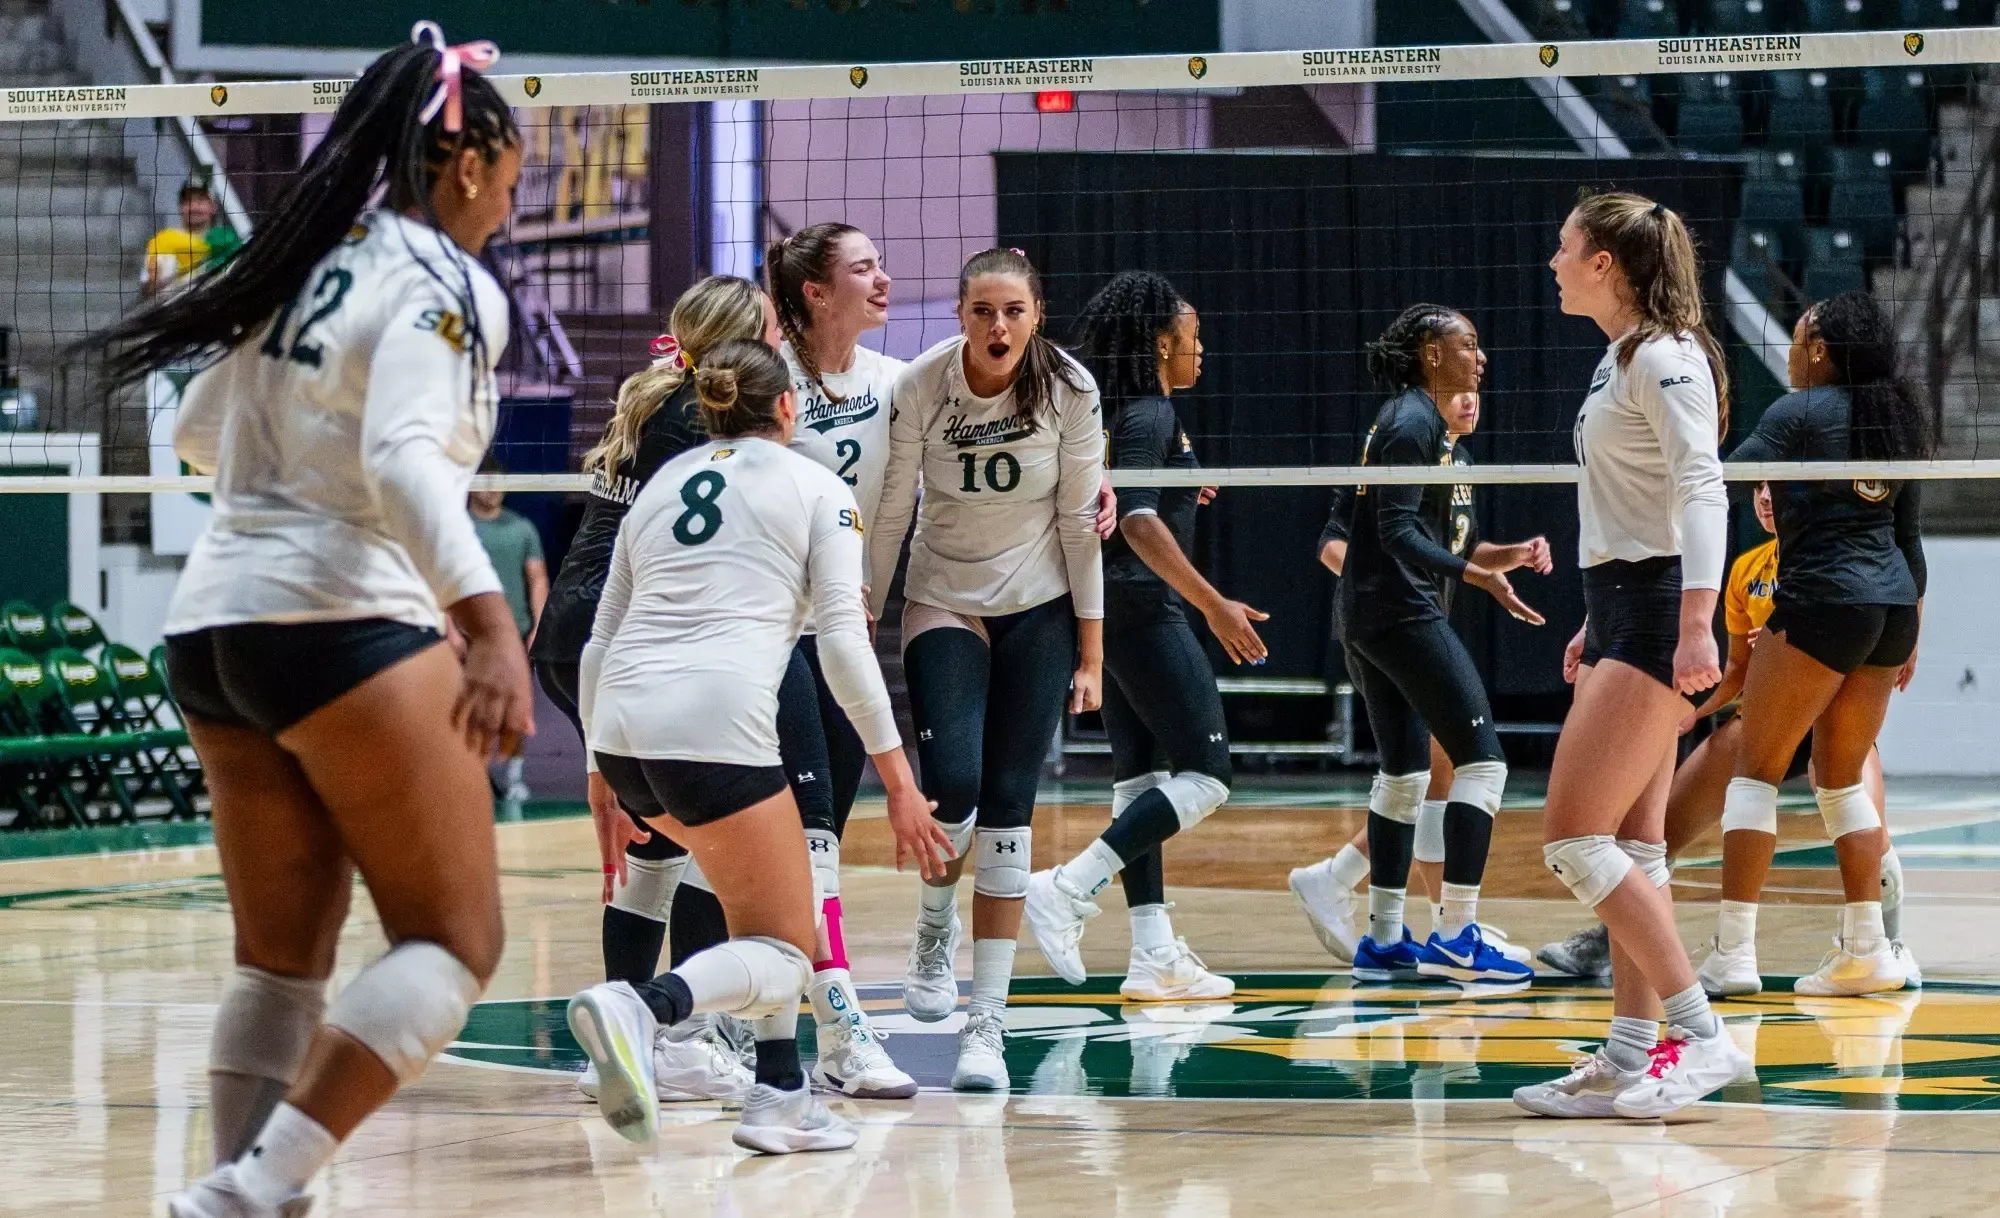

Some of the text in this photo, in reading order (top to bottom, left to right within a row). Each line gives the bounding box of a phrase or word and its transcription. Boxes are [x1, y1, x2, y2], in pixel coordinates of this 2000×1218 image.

[1658, 36, 1801, 53] SOUTHEASTERN
[1302, 48, 1441, 65] SOUTHEASTERN
[1659, 53, 1802, 65] LOUISIANA UNIVERSITY
[960, 59, 1094, 75] SOUTHEASTERN
[1303, 65, 1442, 77] LOUISIANA UNIVERSITY
[630, 69, 759, 85] SOUTHEASTERN
[961, 75, 1094, 87] LOUISIANA UNIVERSITY
[312, 80, 358, 94] SOUT
[631, 85, 759, 97] LOUISIANA UNIVERSITY
[7, 88, 127, 103] SOUTHEASTERN
[8, 103, 127, 114] LOUISIANA UNIVERSITY
[804, 383, 872, 422] Hammond
[942, 413, 1023, 441] Hammon
[975, 435, 1005, 445] AMERICA
[835, 439, 862, 487] 2
[957, 451, 1022, 493] 10
[671, 469, 727, 546] 8
